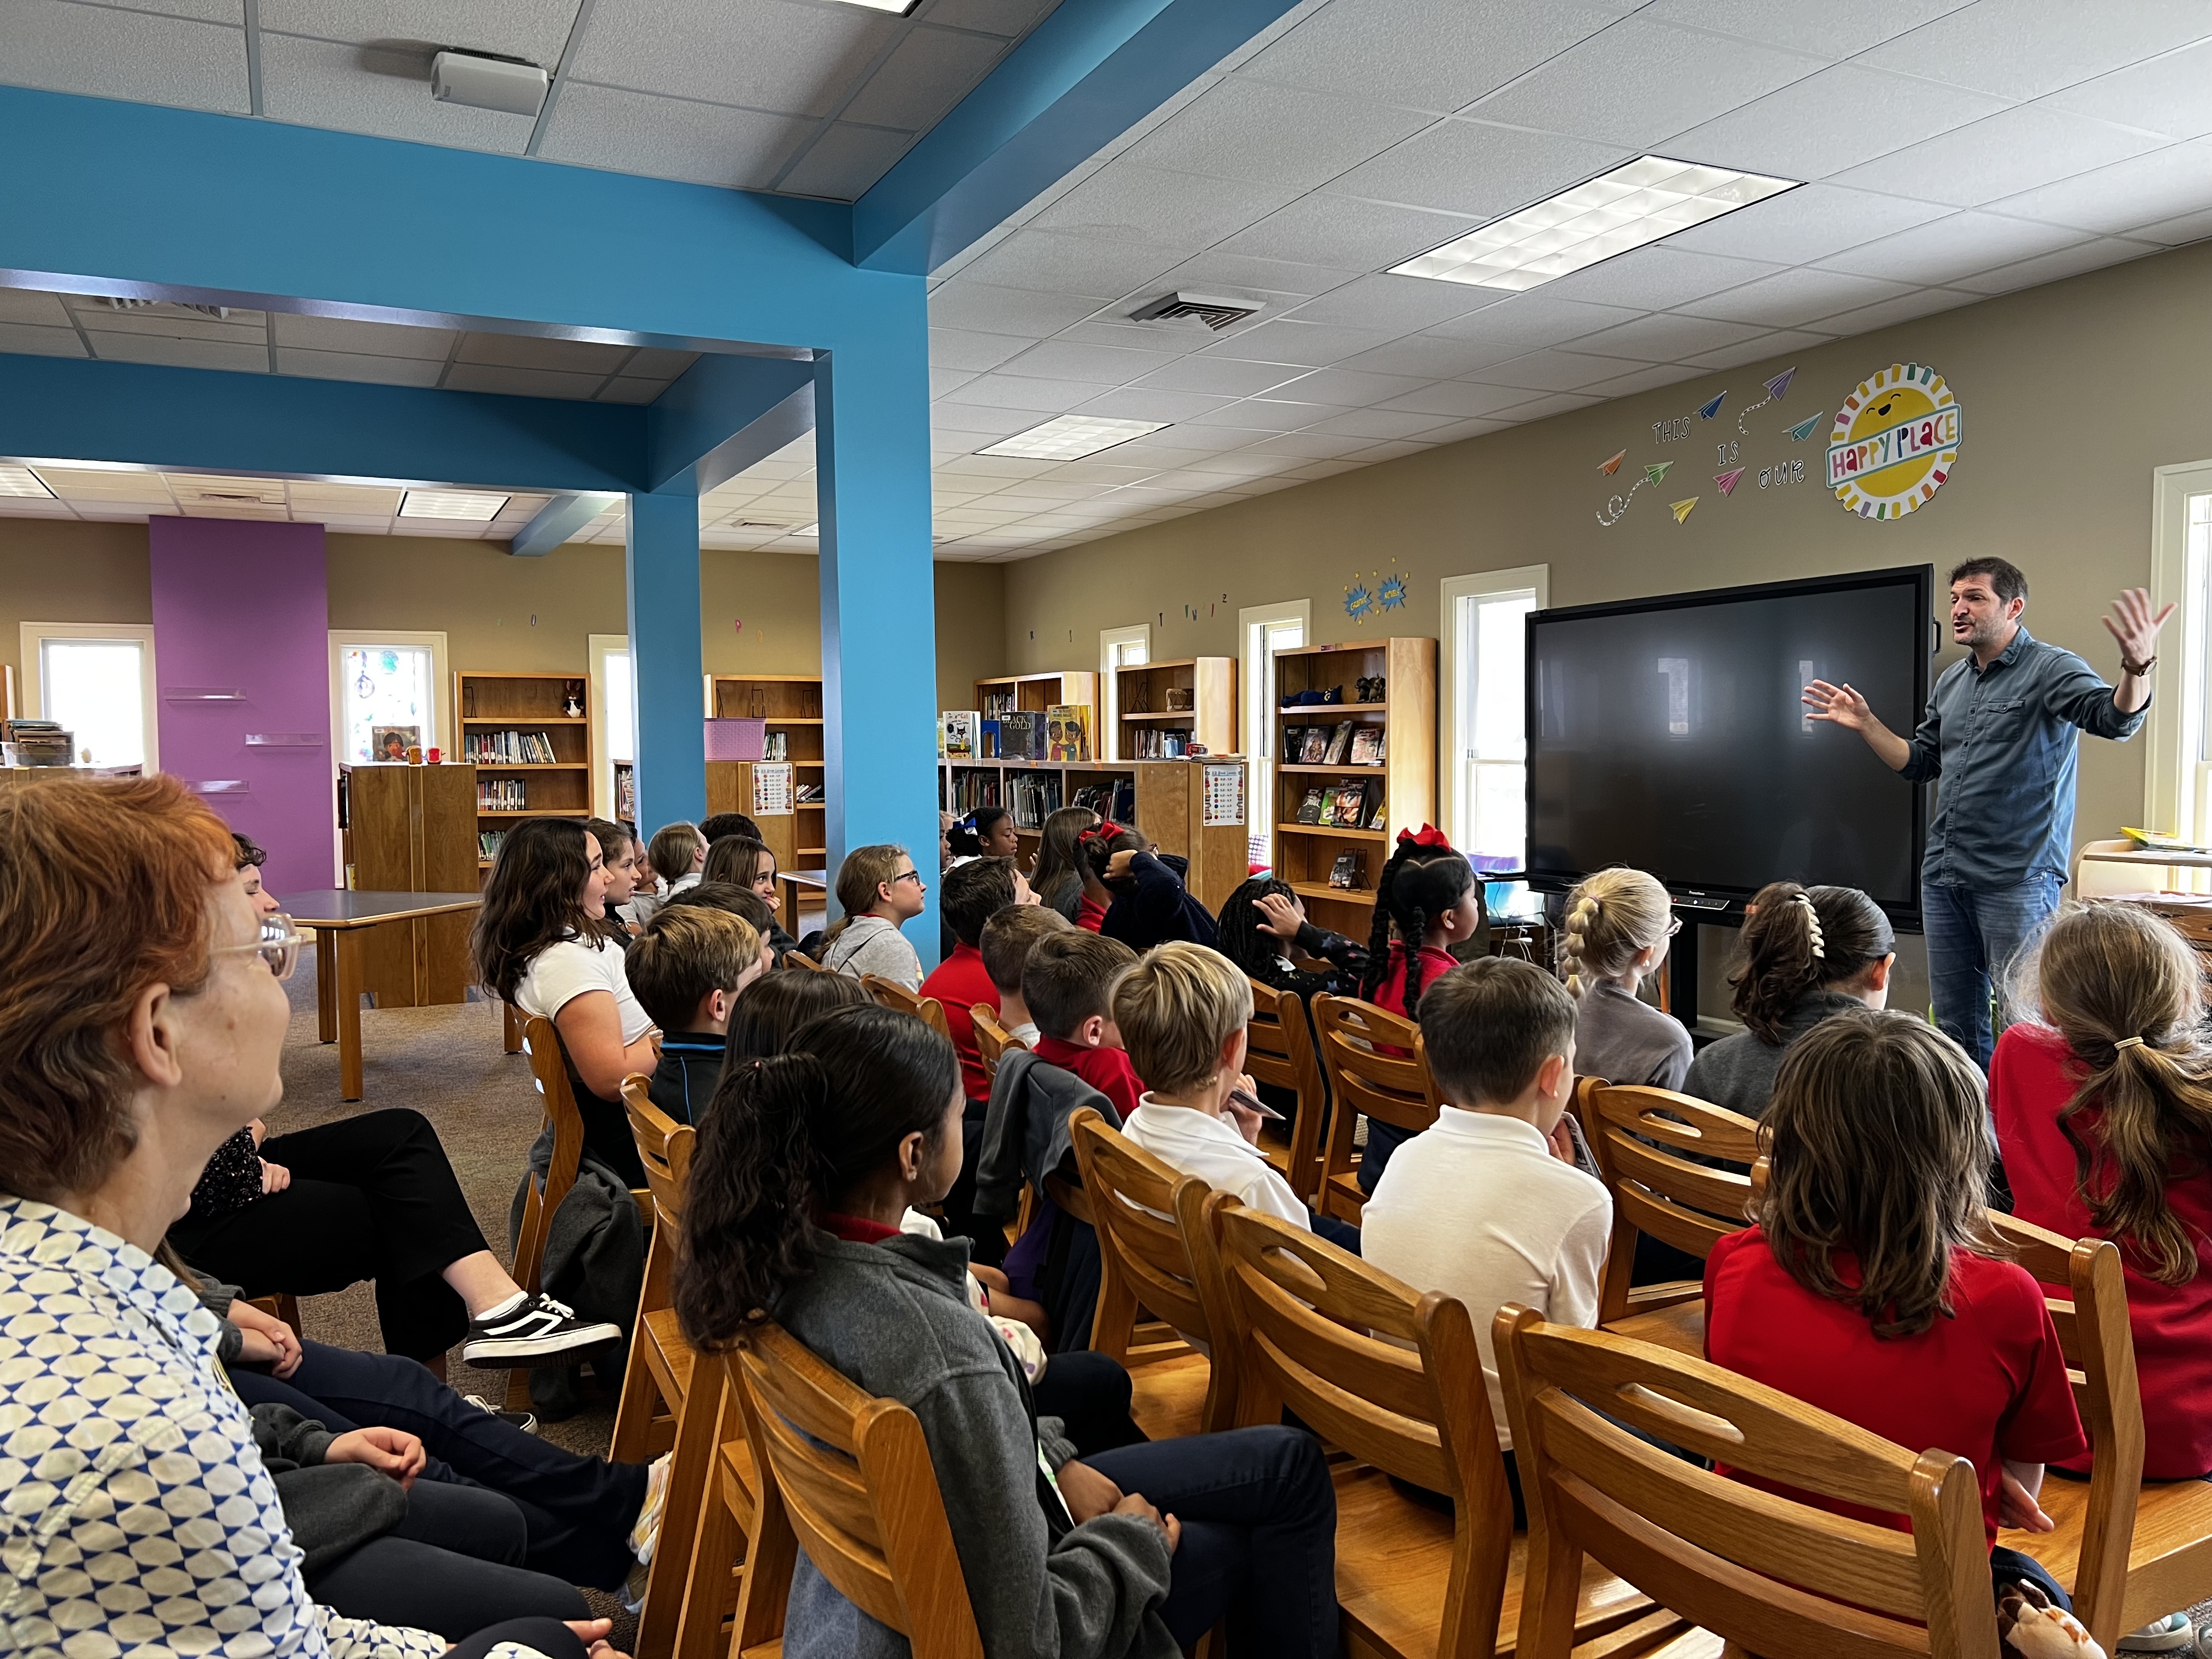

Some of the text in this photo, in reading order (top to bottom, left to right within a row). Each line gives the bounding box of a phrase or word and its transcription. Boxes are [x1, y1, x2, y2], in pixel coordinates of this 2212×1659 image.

[1652, 417, 1690, 444] THIS
[1718, 441, 1739, 466] IS
[1009, 721, 1031, 730] GOLD
[1334, 866, 1351, 874] GUYS
